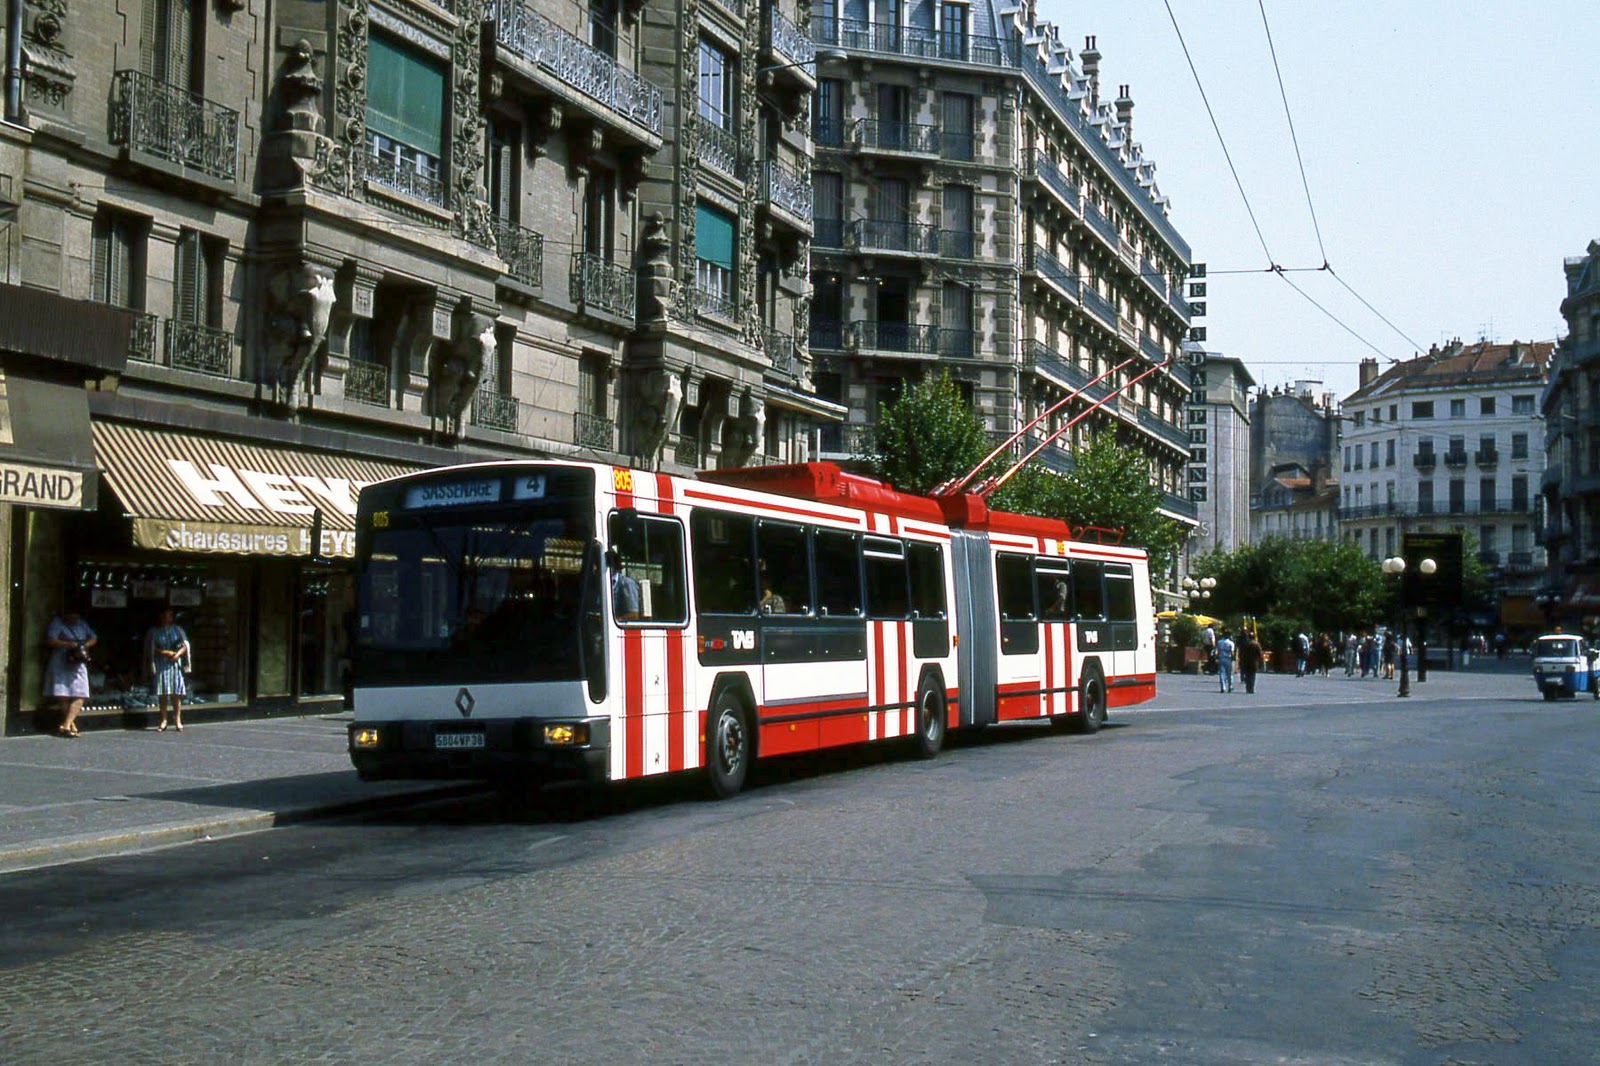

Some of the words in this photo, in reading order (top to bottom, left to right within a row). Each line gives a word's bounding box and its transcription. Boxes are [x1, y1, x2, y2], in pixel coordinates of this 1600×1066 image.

[1191, 352, 1205, 500] DAUPHINS
[0, 469, 74, 501] RAND
[526, 478, 540, 493] 4
[614, 469, 633, 491] 805
[421, 481, 492, 501] SASSENAGE
[373, 511, 389, 527] 805
